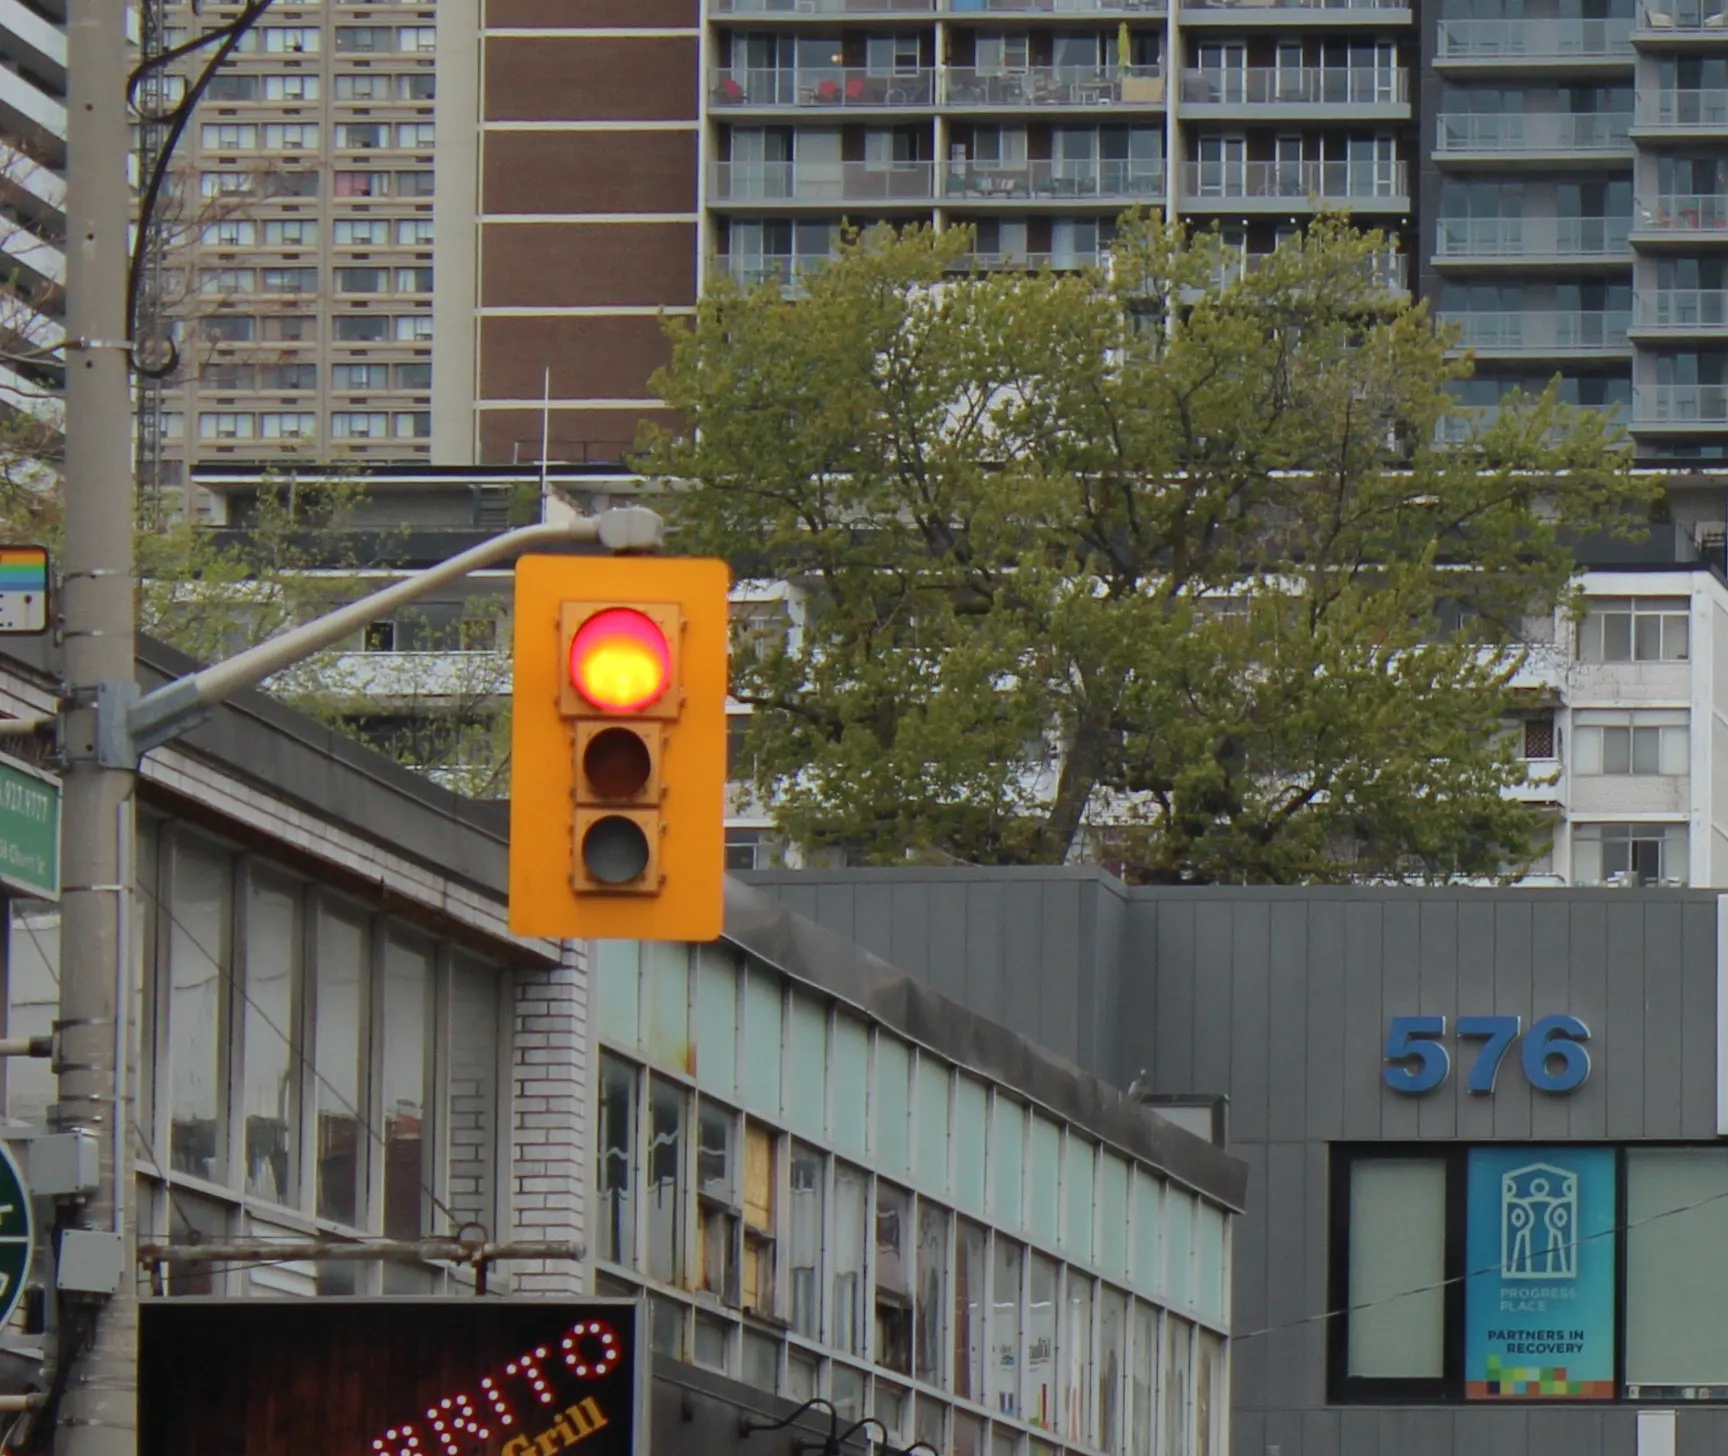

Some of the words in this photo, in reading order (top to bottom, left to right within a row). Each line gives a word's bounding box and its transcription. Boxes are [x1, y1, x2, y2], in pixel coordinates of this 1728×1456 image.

[1383, 1014, 1592, 1096] 576
[1500, 1287, 1577, 1299] PROGRESS
[1500, 1300, 1546, 1312] PLACE
[1488, 1330, 1565, 1341] PARTNERS
[1569, 1330, 1584, 1341] IN
[1506, 1343, 1584, 1354] RECOVERY
